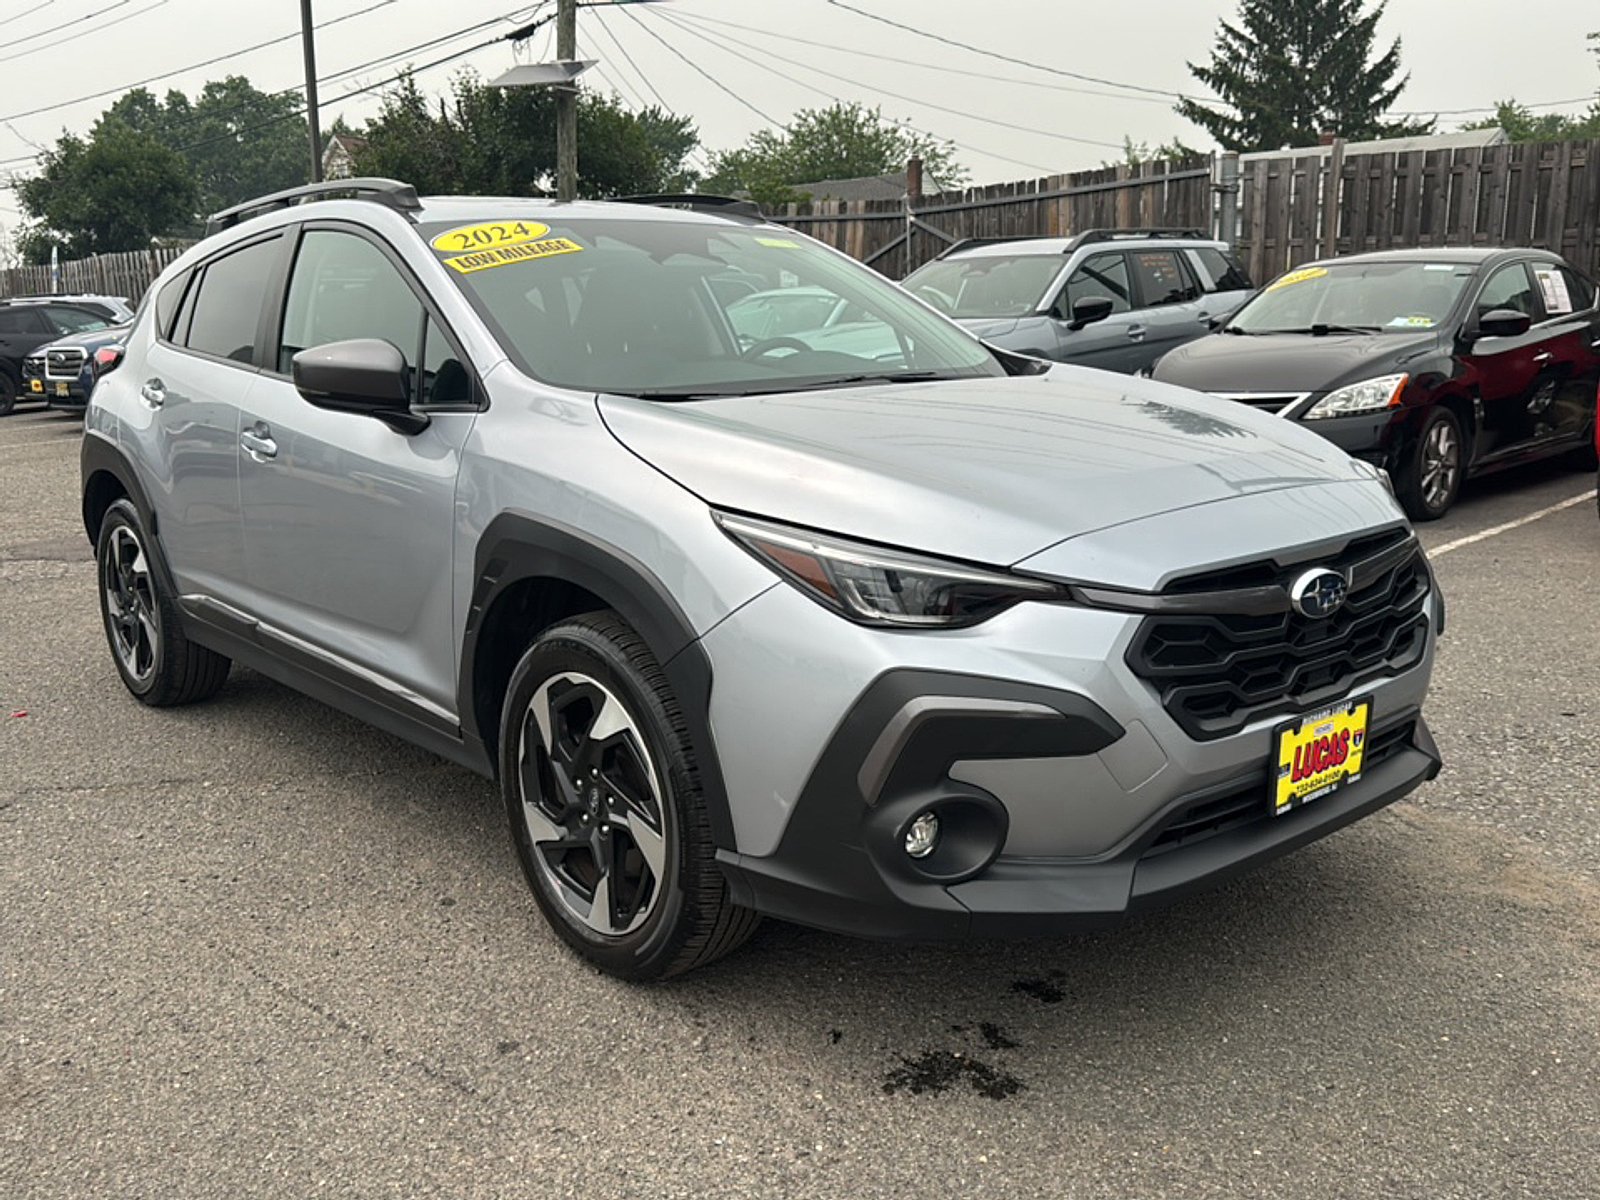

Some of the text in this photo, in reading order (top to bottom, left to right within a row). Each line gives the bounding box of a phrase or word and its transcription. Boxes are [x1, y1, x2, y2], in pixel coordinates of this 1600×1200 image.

[453, 222, 530, 250] 2024
[454, 240, 571, 269] LOW MILEAGE
[1291, 728, 1350, 783] LUCAS
